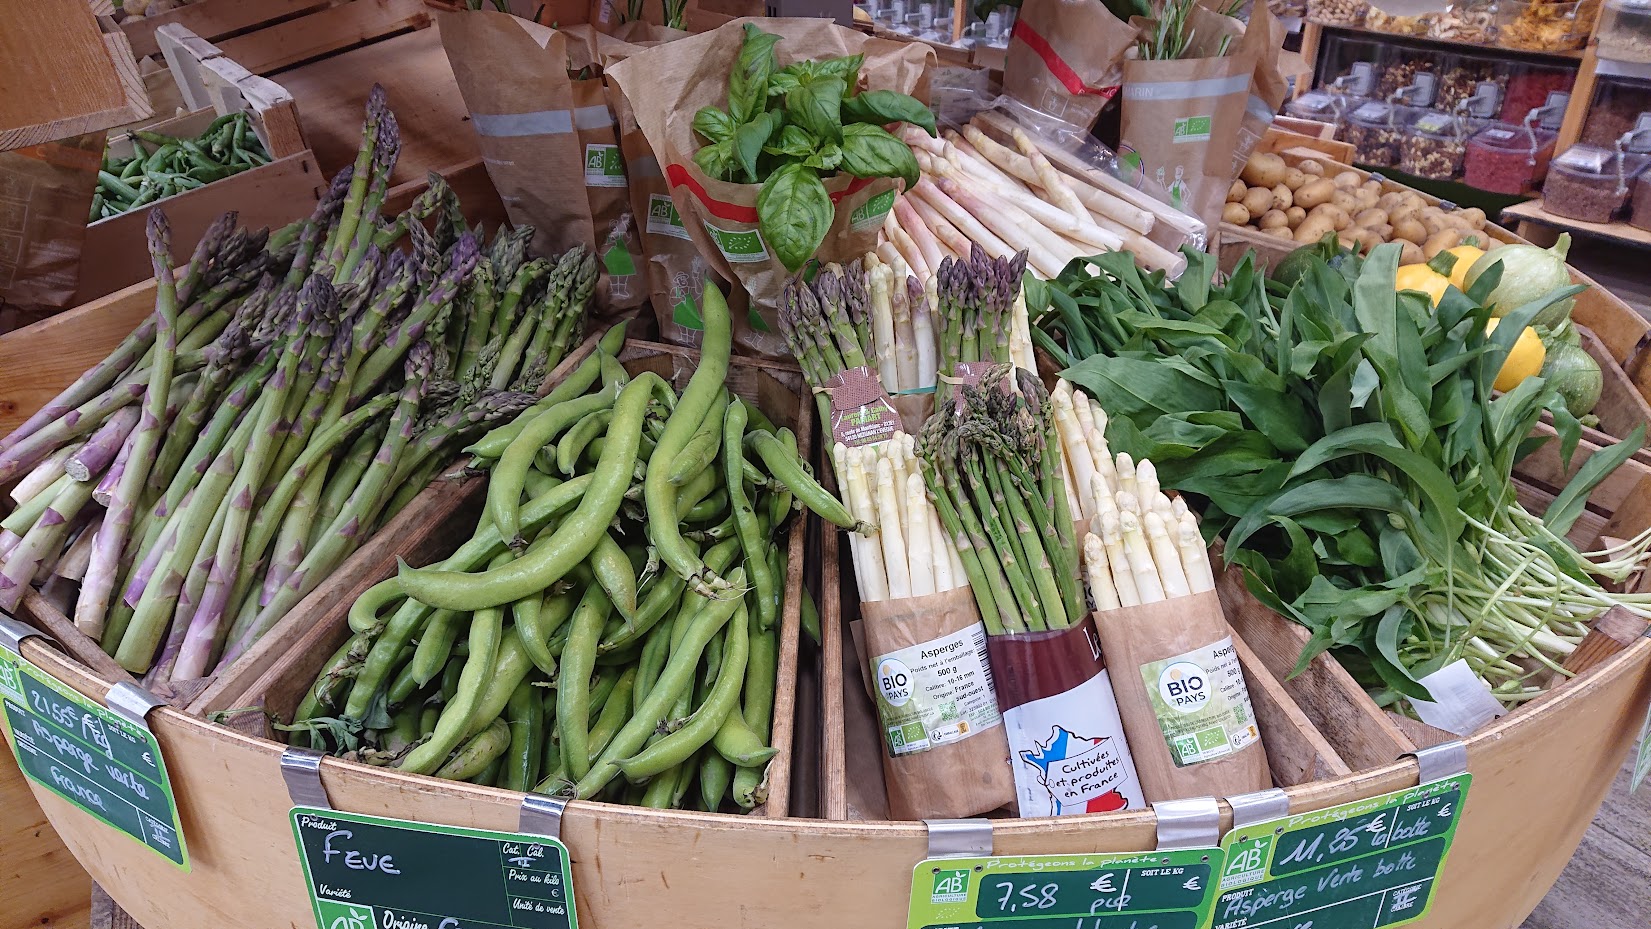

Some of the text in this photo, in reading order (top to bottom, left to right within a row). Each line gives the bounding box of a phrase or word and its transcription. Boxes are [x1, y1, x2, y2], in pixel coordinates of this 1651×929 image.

[587, 155, 603, 168] AB
[651, 205, 668, 217] AB
[921, 639, 964, 660] Asperges
[910, 665, 928, 674] Poids
[928, 661, 939, 669] net
[937, 666, 958, 677] 500 g
[963, 670, 975, 679] mm
[882, 673, 907, 691] BIO
[954, 681, 975, 693] France
[1167, 676, 1203, 697] BIO
[889, 688, 909, 699] PAYS
[955, 685, 984, 702] sud-ouest
[1176, 691, 1206, 706] PAYS
[1181, 743, 1196, 757] AB
[31, 718, 150, 801] Asperge verte
[141, 751, 156, 768] €
[1062, 751, 1109, 774] Cultivées
[1056, 757, 1120, 787] et produites
[50, 764, 107, 812] France
[1064, 772, 1119, 798] en France
[1288, 803, 1379, 828] Protégeons
[1386, 794, 1398, 806] la
[1437, 802, 1452, 817] €
[300, 815, 337, 831] Produit
[1365, 812, 1387, 833] €
[1370, 816, 1432, 847] la botte
[502, 842, 544, 858] Cat. Cal.
[986, 855, 1158, 871] Protégeons la planète
[1226, 847, 1262, 875] AB
[1372, 851, 1417, 878] botte
[508, 868, 560, 886] Prix au kilo
[1140, 867, 1185, 877] SOIT LE KG
[1222, 869, 1265, 883] AGRICULTURE
[934, 877, 963, 894] AB
[1182, 875, 1202, 891] €
[1220, 875, 1264, 888] BIOLOGIQUE
[319, 883, 352, 899] Variété
[551, 888, 560, 898] €
[996, 872, 1118, 913] 7,58 €
[1221, 887, 1254, 903] PRODUIT
[512, 897, 565, 915] Unité de vente
